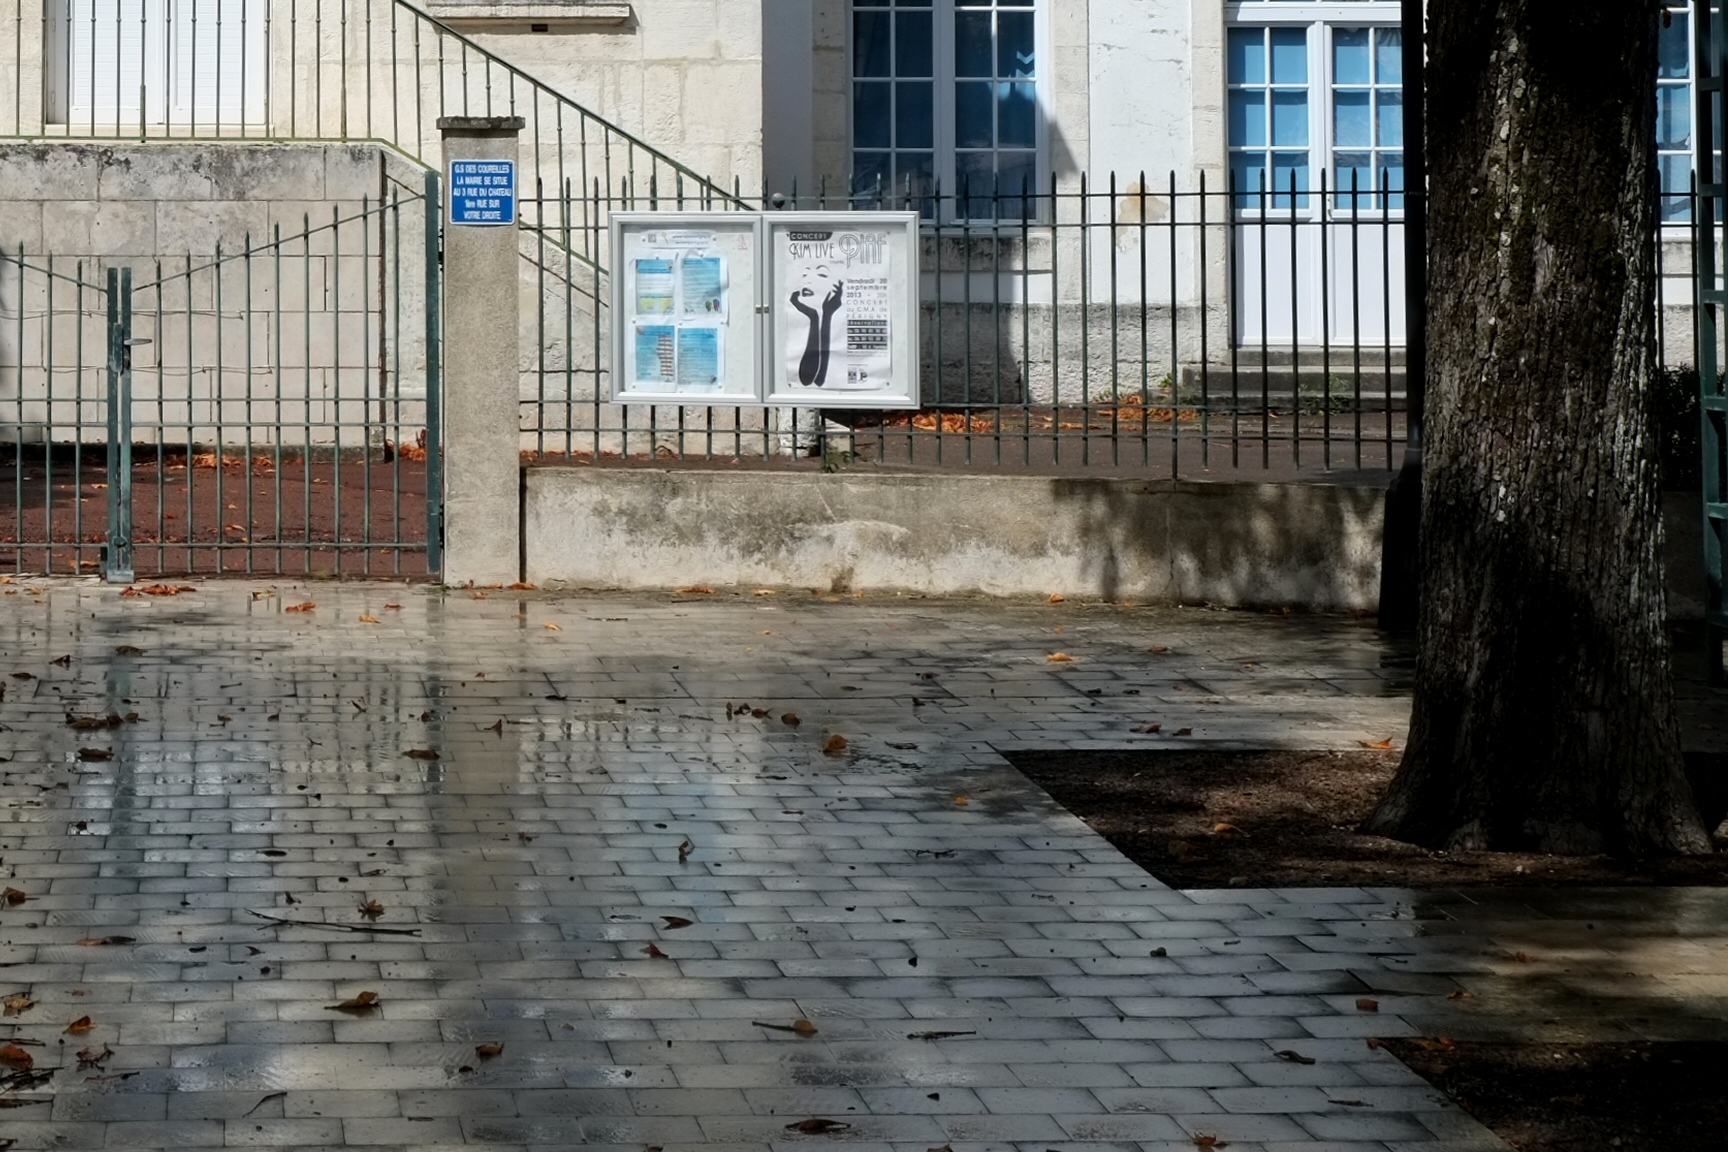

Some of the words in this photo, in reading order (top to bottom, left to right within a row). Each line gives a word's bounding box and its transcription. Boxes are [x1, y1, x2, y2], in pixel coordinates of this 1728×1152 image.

[466, 164, 476, 173] DES
[456, 176, 464, 185] LA
[465, 176, 482, 185] MAIRIE
[484, 176, 491, 185] SE
[492, 176, 508, 185] SITUE
[454, 188, 461, 196] AU
[462, 188, 466, 196] 3
[467, 188, 478, 196] RUE
[479, 188, 487, 196] DU
[477, 199, 487, 208] RUE
[489, 199, 500, 208] SUR
[463, 211, 480, 219] VOTRE
[482, 211, 501, 219] DROITE
[789, 243, 811, 260] KIM
[816, 243, 834, 258] LIVE
[839, 233, 887, 269] PIAF
